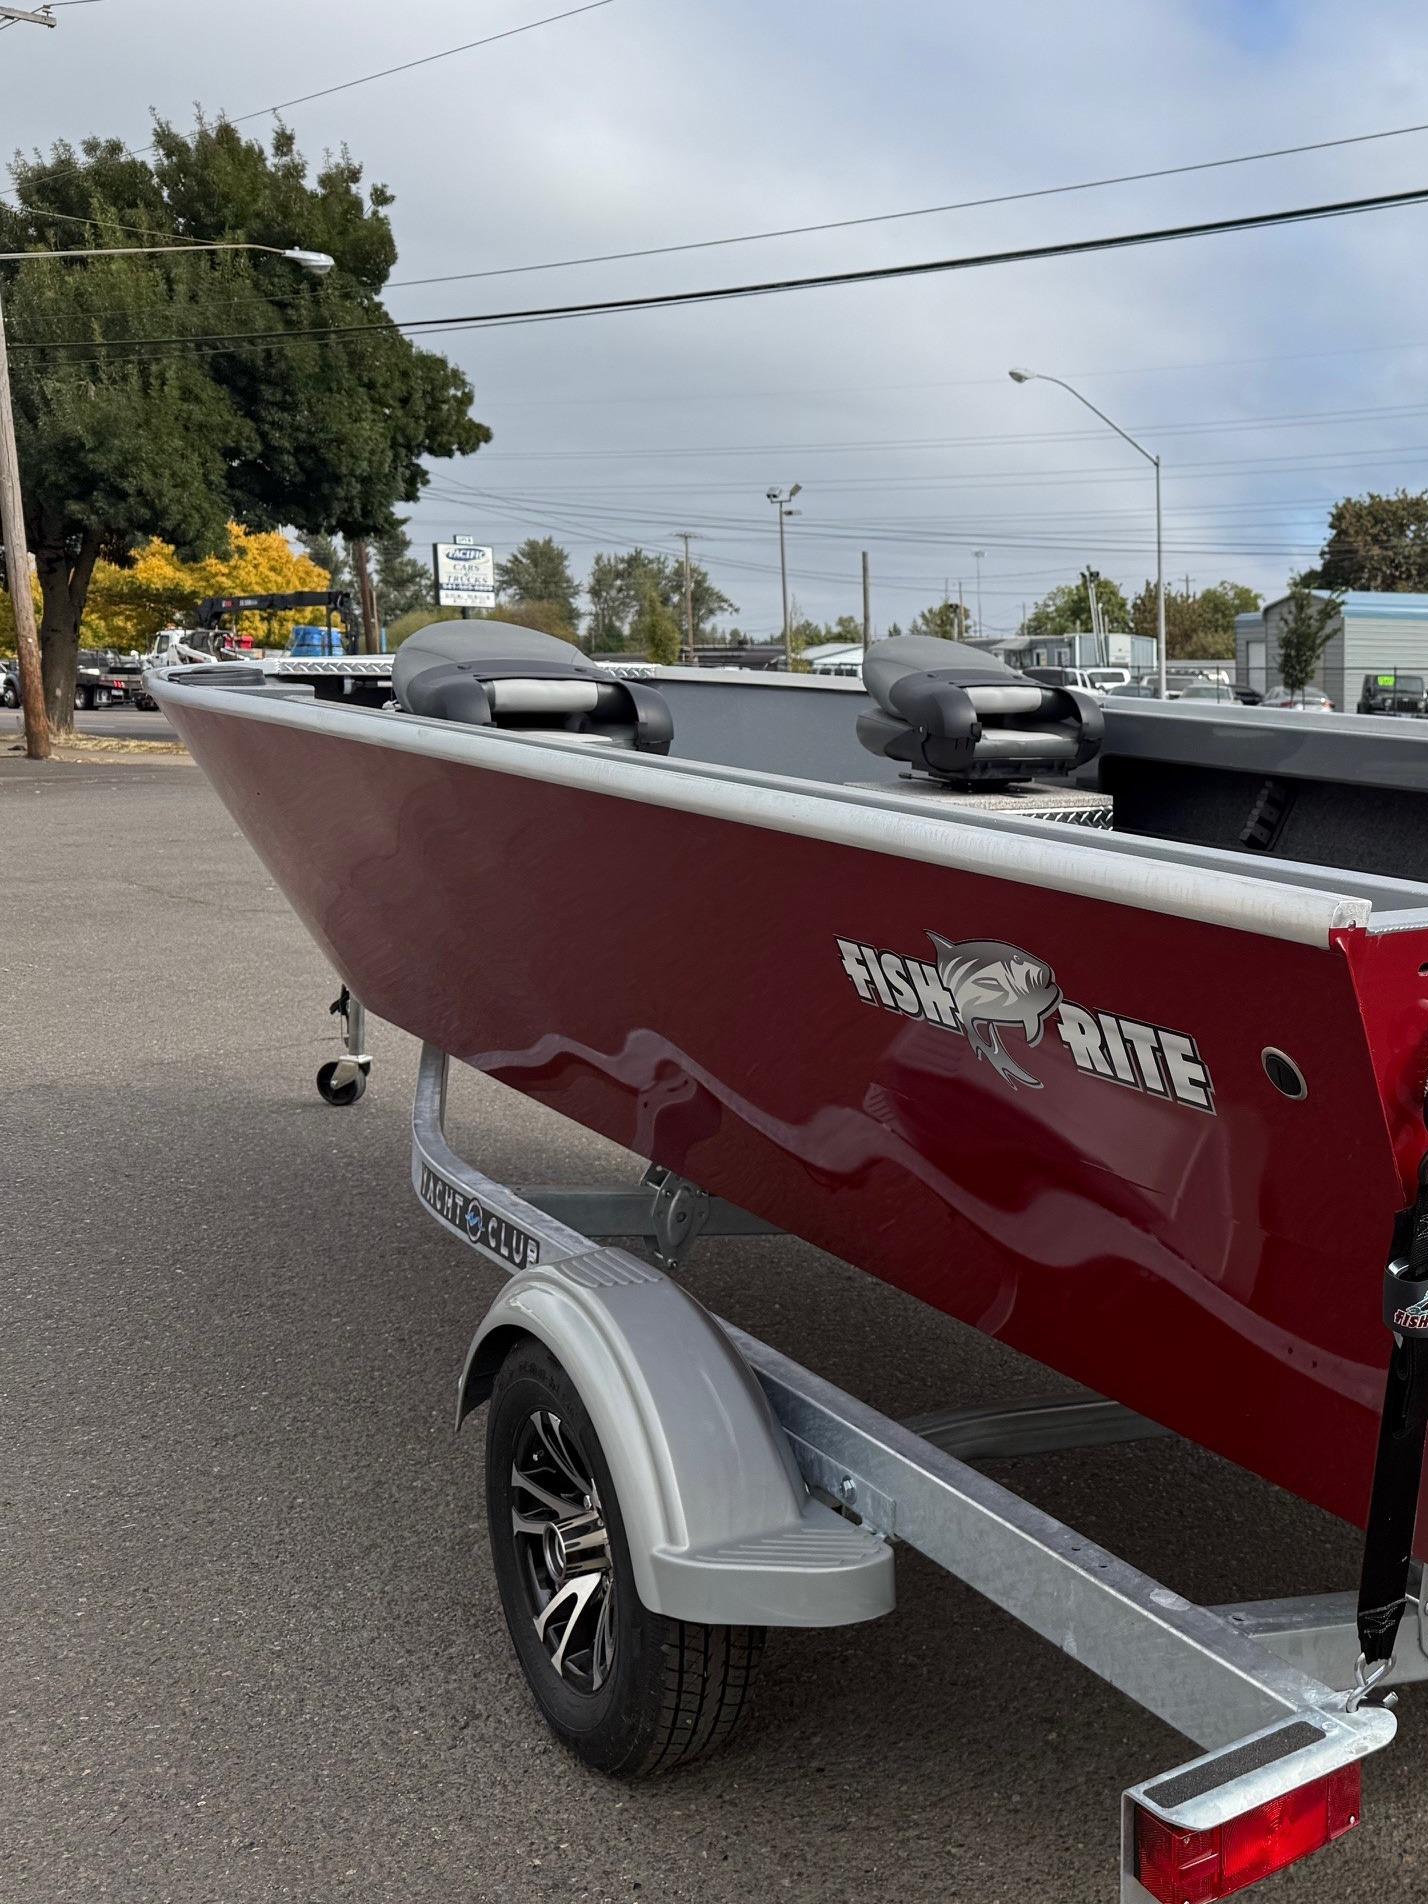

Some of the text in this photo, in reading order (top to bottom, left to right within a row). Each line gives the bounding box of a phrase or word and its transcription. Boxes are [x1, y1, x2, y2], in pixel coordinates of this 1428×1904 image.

[448, 548, 486, 560] PACIFIC
[453, 563, 480, 572] CARS
[447, 575, 488, 584] TRUCKS
[834, 935, 1217, 1115] FISH RITE
[421, 1167, 464, 1225] YACHT
